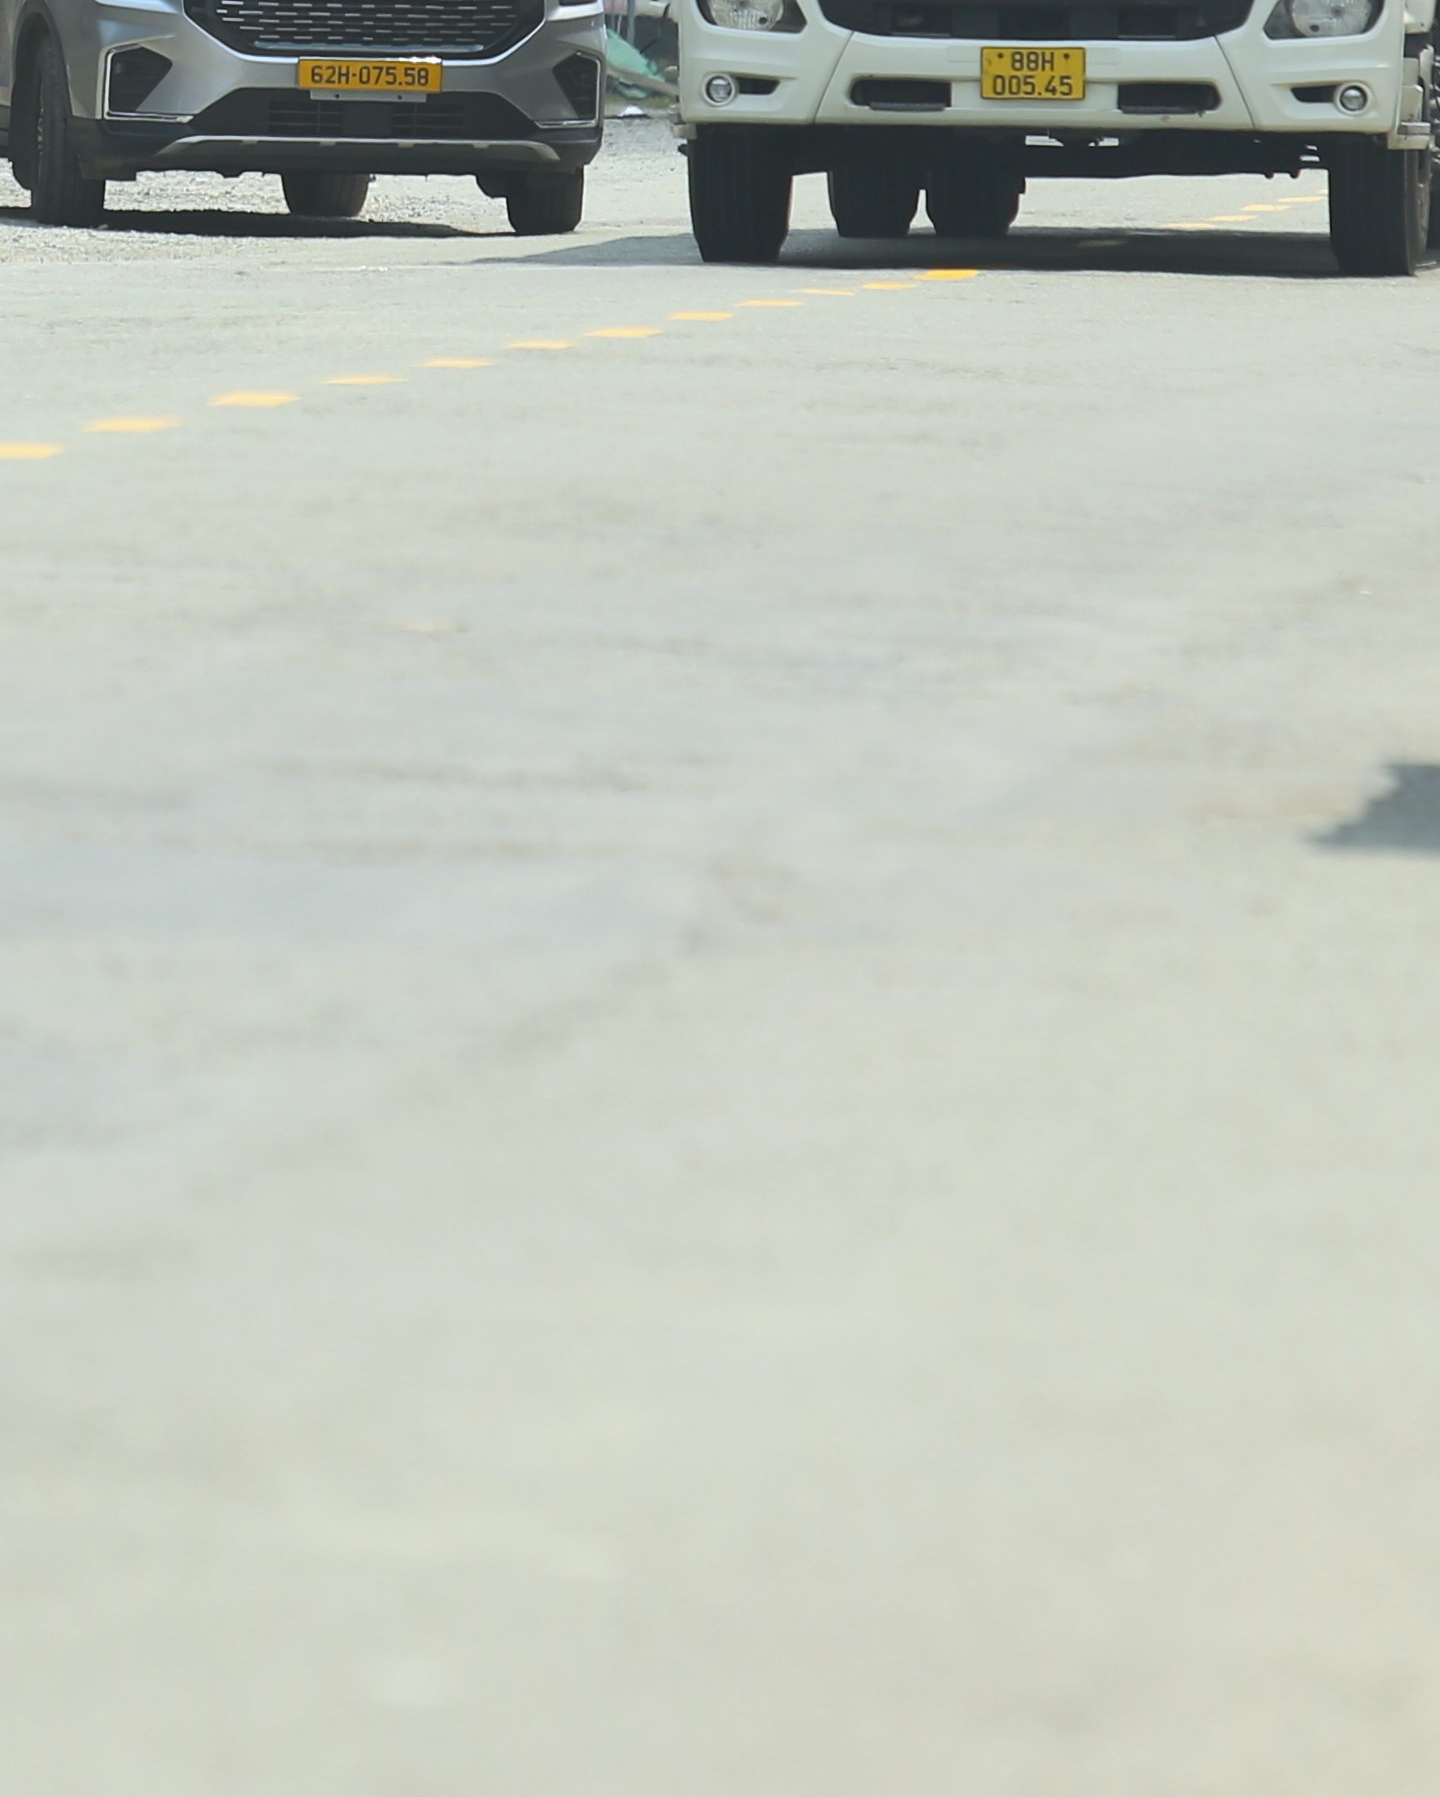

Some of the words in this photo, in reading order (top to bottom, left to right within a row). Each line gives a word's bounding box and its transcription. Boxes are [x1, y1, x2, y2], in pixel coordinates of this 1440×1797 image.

[1011, 50, 1055, 72] 88H
[310, 65, 430, 87] 62H-075.58
[992, 74, 1073, 97] 005.45
